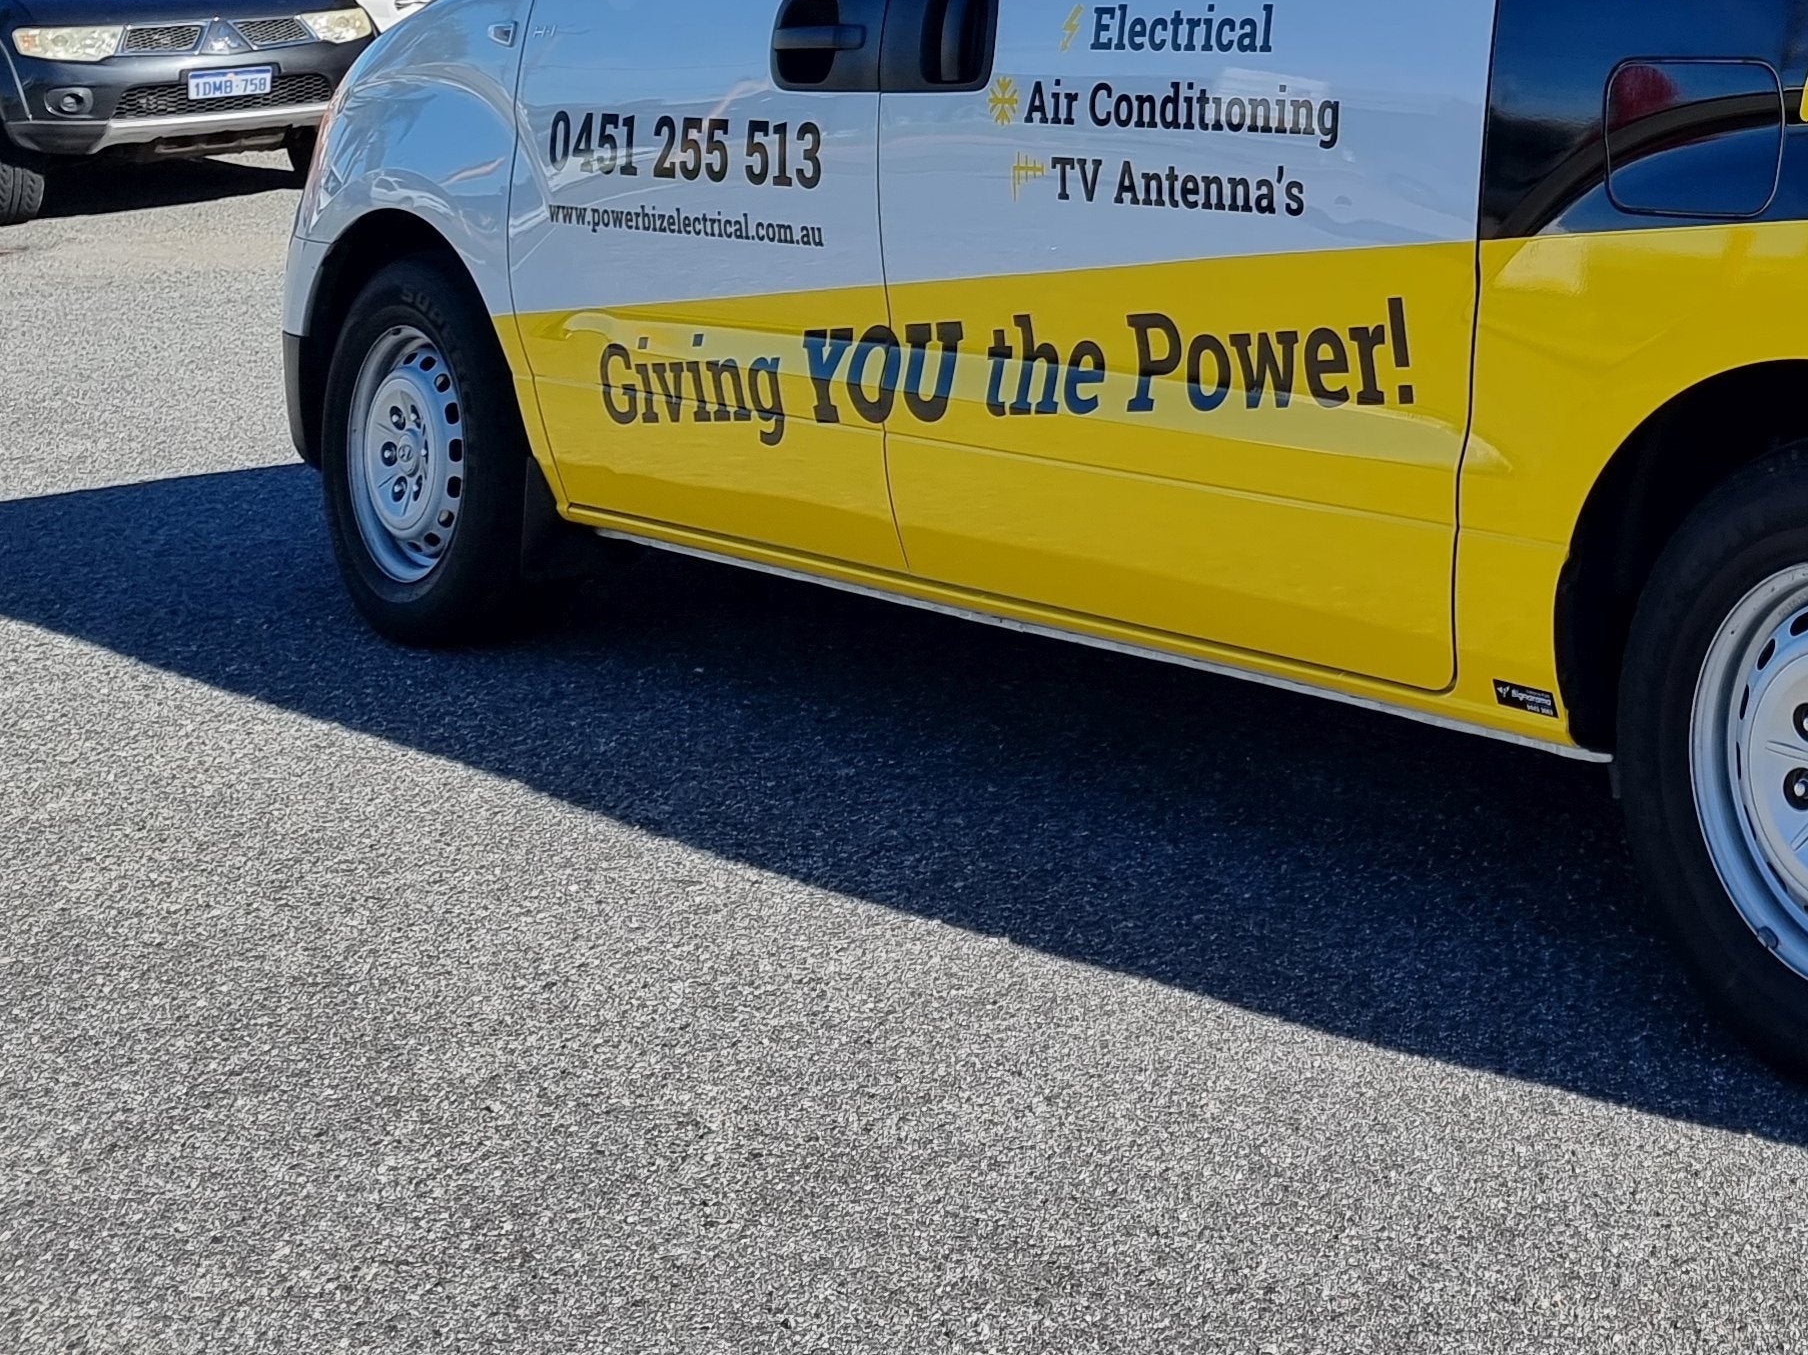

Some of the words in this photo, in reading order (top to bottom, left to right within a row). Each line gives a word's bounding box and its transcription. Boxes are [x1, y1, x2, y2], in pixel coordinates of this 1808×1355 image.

[1090, 4, 1273, 52] Electrical
[1024, 79, 1079, 125] Air
[1089, 81, 1340, 149] Conditioning
[550, 110, 638, 176] 0451
[653, 115, 729, 182] 255
[745, 120, 821, 189] 513
[1051, 157, 1102, 203] TV
[1114, 160, 1304, 217] Antenna's
[549, 204, 824, 247] www.powerbizelectrical.com.au
[600, 333, 785, 446] Giving
[802, 322, 963, 423] YOU
[986, 313, 1105, 417] the
[1125, 297, 1414, 412] Power!
